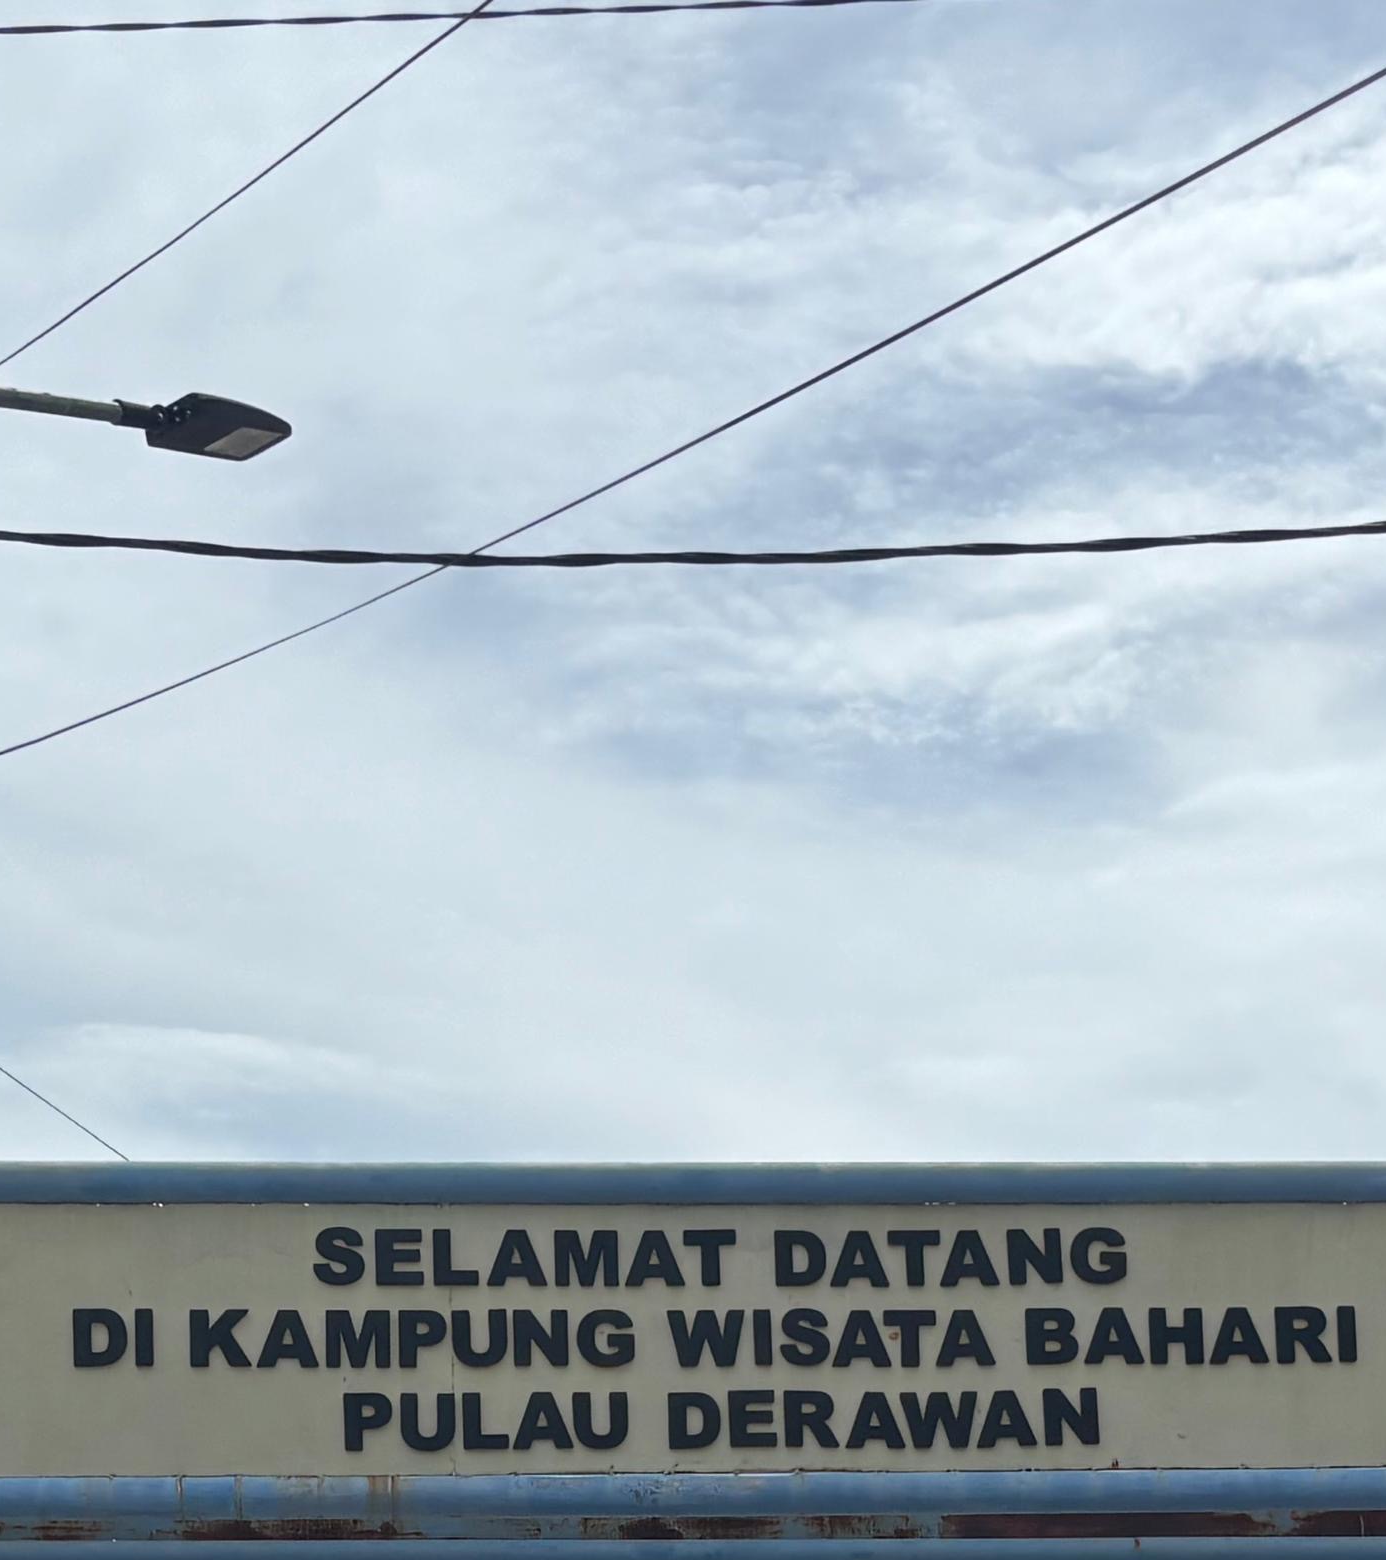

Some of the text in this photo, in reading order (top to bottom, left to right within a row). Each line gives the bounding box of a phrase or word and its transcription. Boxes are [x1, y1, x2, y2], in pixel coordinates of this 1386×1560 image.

[312, 1226, 1128, 1289] SELAMAT DATANG
[72, 1305, 1358, 1369] DI KAMPUNG WISATA BAHARI
[342, 1387, 1101, 1453] PULAU DERAWAN
